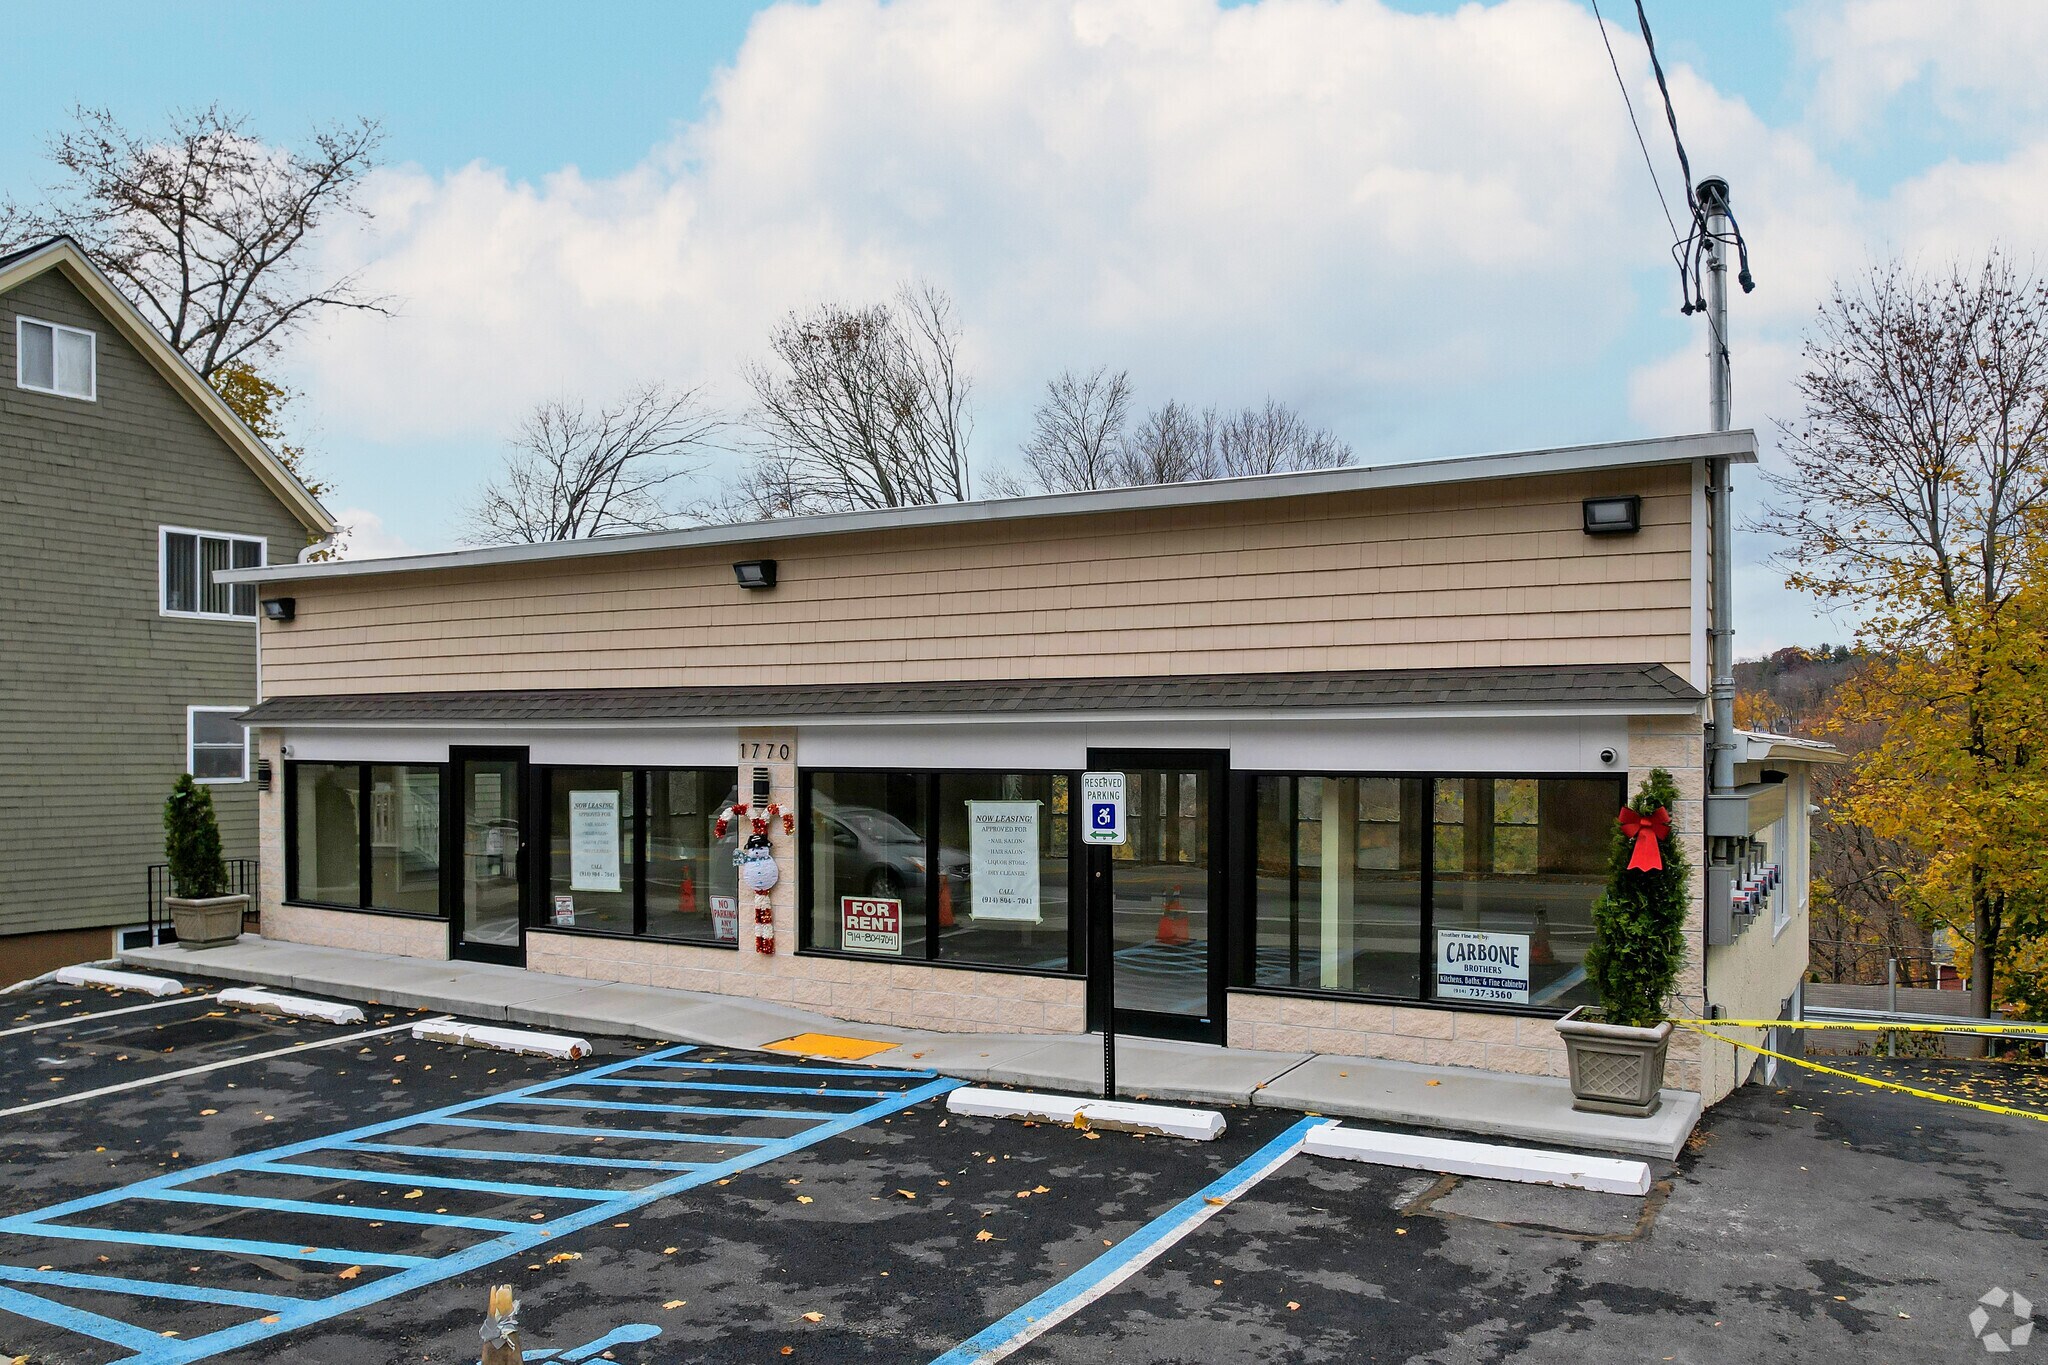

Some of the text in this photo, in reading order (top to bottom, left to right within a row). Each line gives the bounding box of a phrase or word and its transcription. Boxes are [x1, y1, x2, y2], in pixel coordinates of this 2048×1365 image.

[740, 743, 790, 760] 1770
[1085, 778, 1122, 788] RESERVED
[1088, 791, 1120, 800] PARKING
[976, 815, 1033, 824] NOW LEASING!
[718, 900, 729, 909] NO
[982, 896, 998, 904] (914)
[714, 909, 737, 919] PARKING
[852, 902, 890, 917] FOR
[721, 919, 732, 927] ANY
[847, 915, 896, 931] RENT
[721, 927, 734, 935] TIME
[1446, 942, 1520, 969] CARBONE
[1464, 964, 1502, 975] BROTHERS
[1488, 978, 1500, 987] Fine
[1501, 979, 1527, 990] Cabinetry
[1469, 988, 1513, 999] 737-3560
